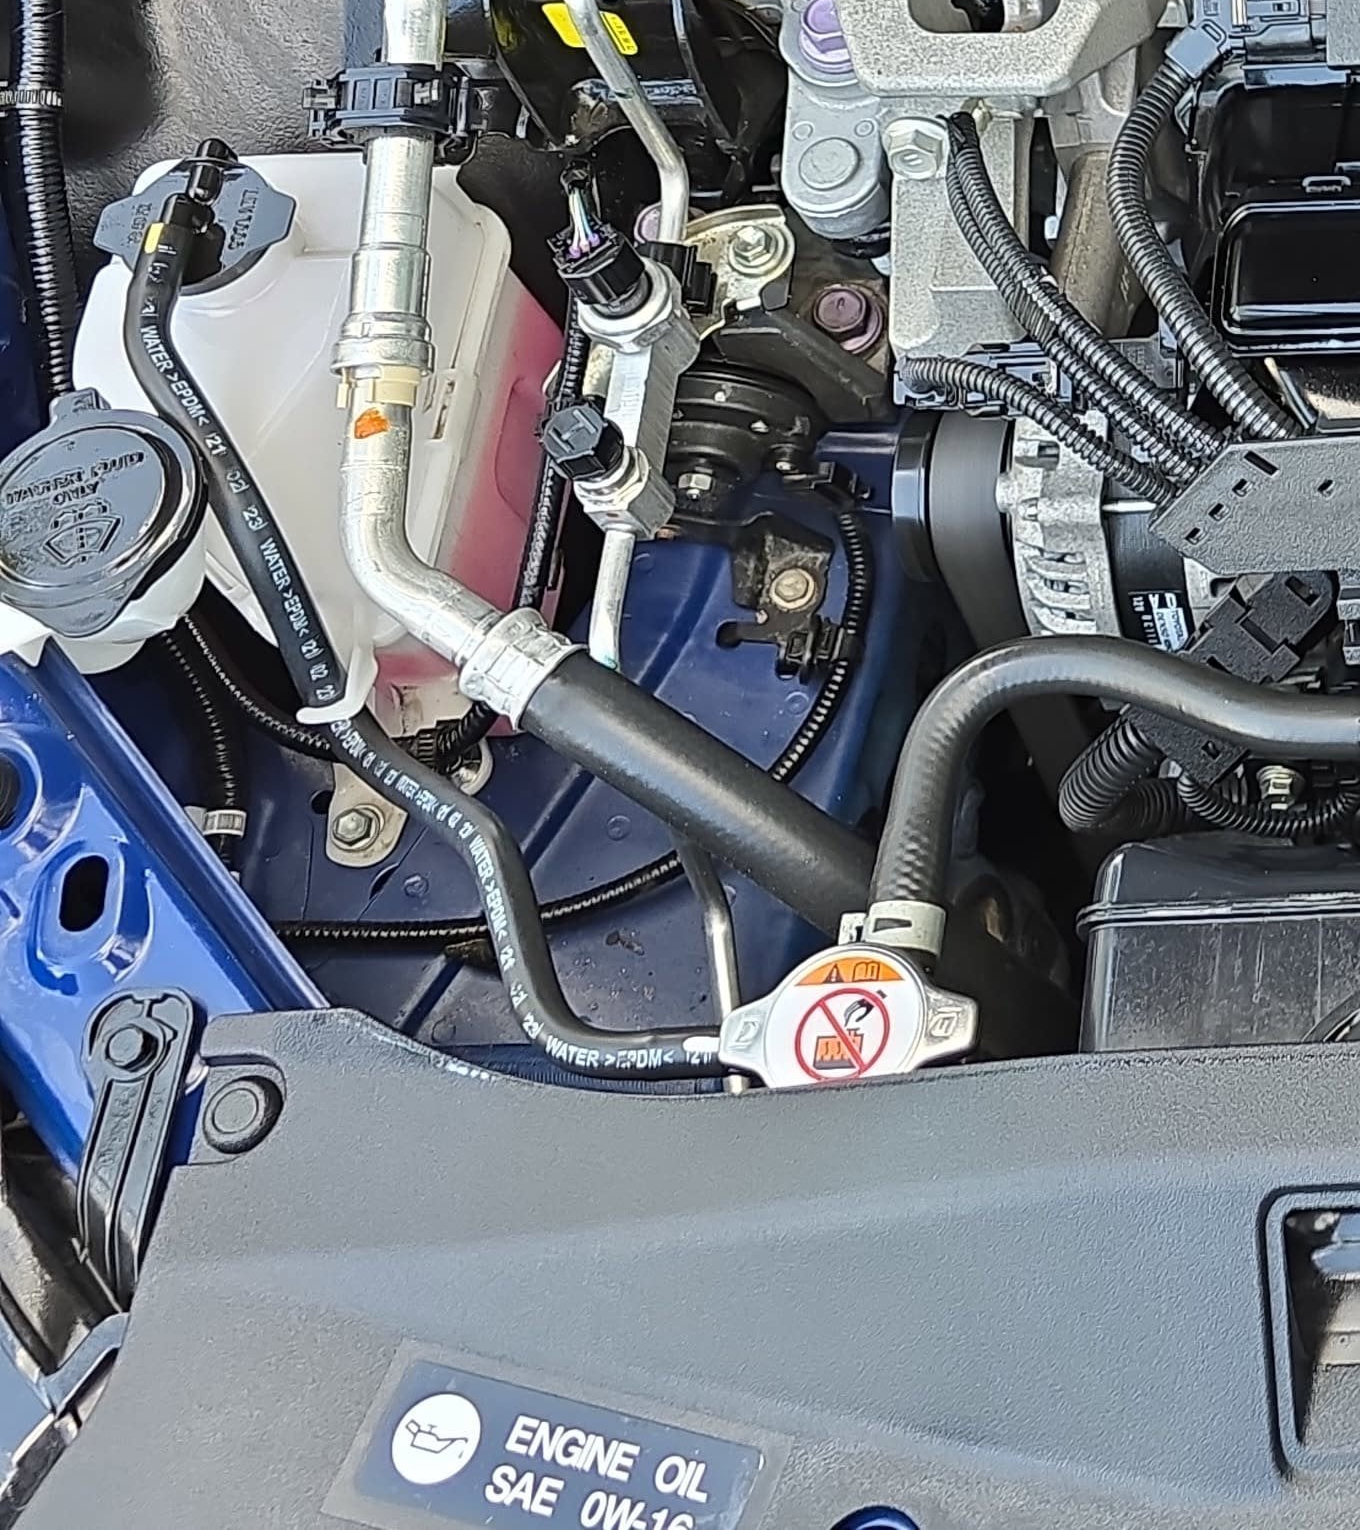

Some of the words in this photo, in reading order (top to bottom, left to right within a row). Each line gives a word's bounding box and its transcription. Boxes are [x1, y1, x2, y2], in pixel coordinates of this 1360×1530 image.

[139, 324, 175, 374] WATER
[165, 370, 211, 428] >EPDM<
[52, 481, 99, 505] ONLY
[258, 537, 292, 591] WATER
[282, 588, 309, 637] >EPDM<
[468, 834, 494, 881] WATER
[545, 1036, 600, 1068] WATER
[505, 1415, 640, 1482] ENGINE
[654, 1455, 708, 1503] OIL
[485, 1465, 564, 1517] SAE
